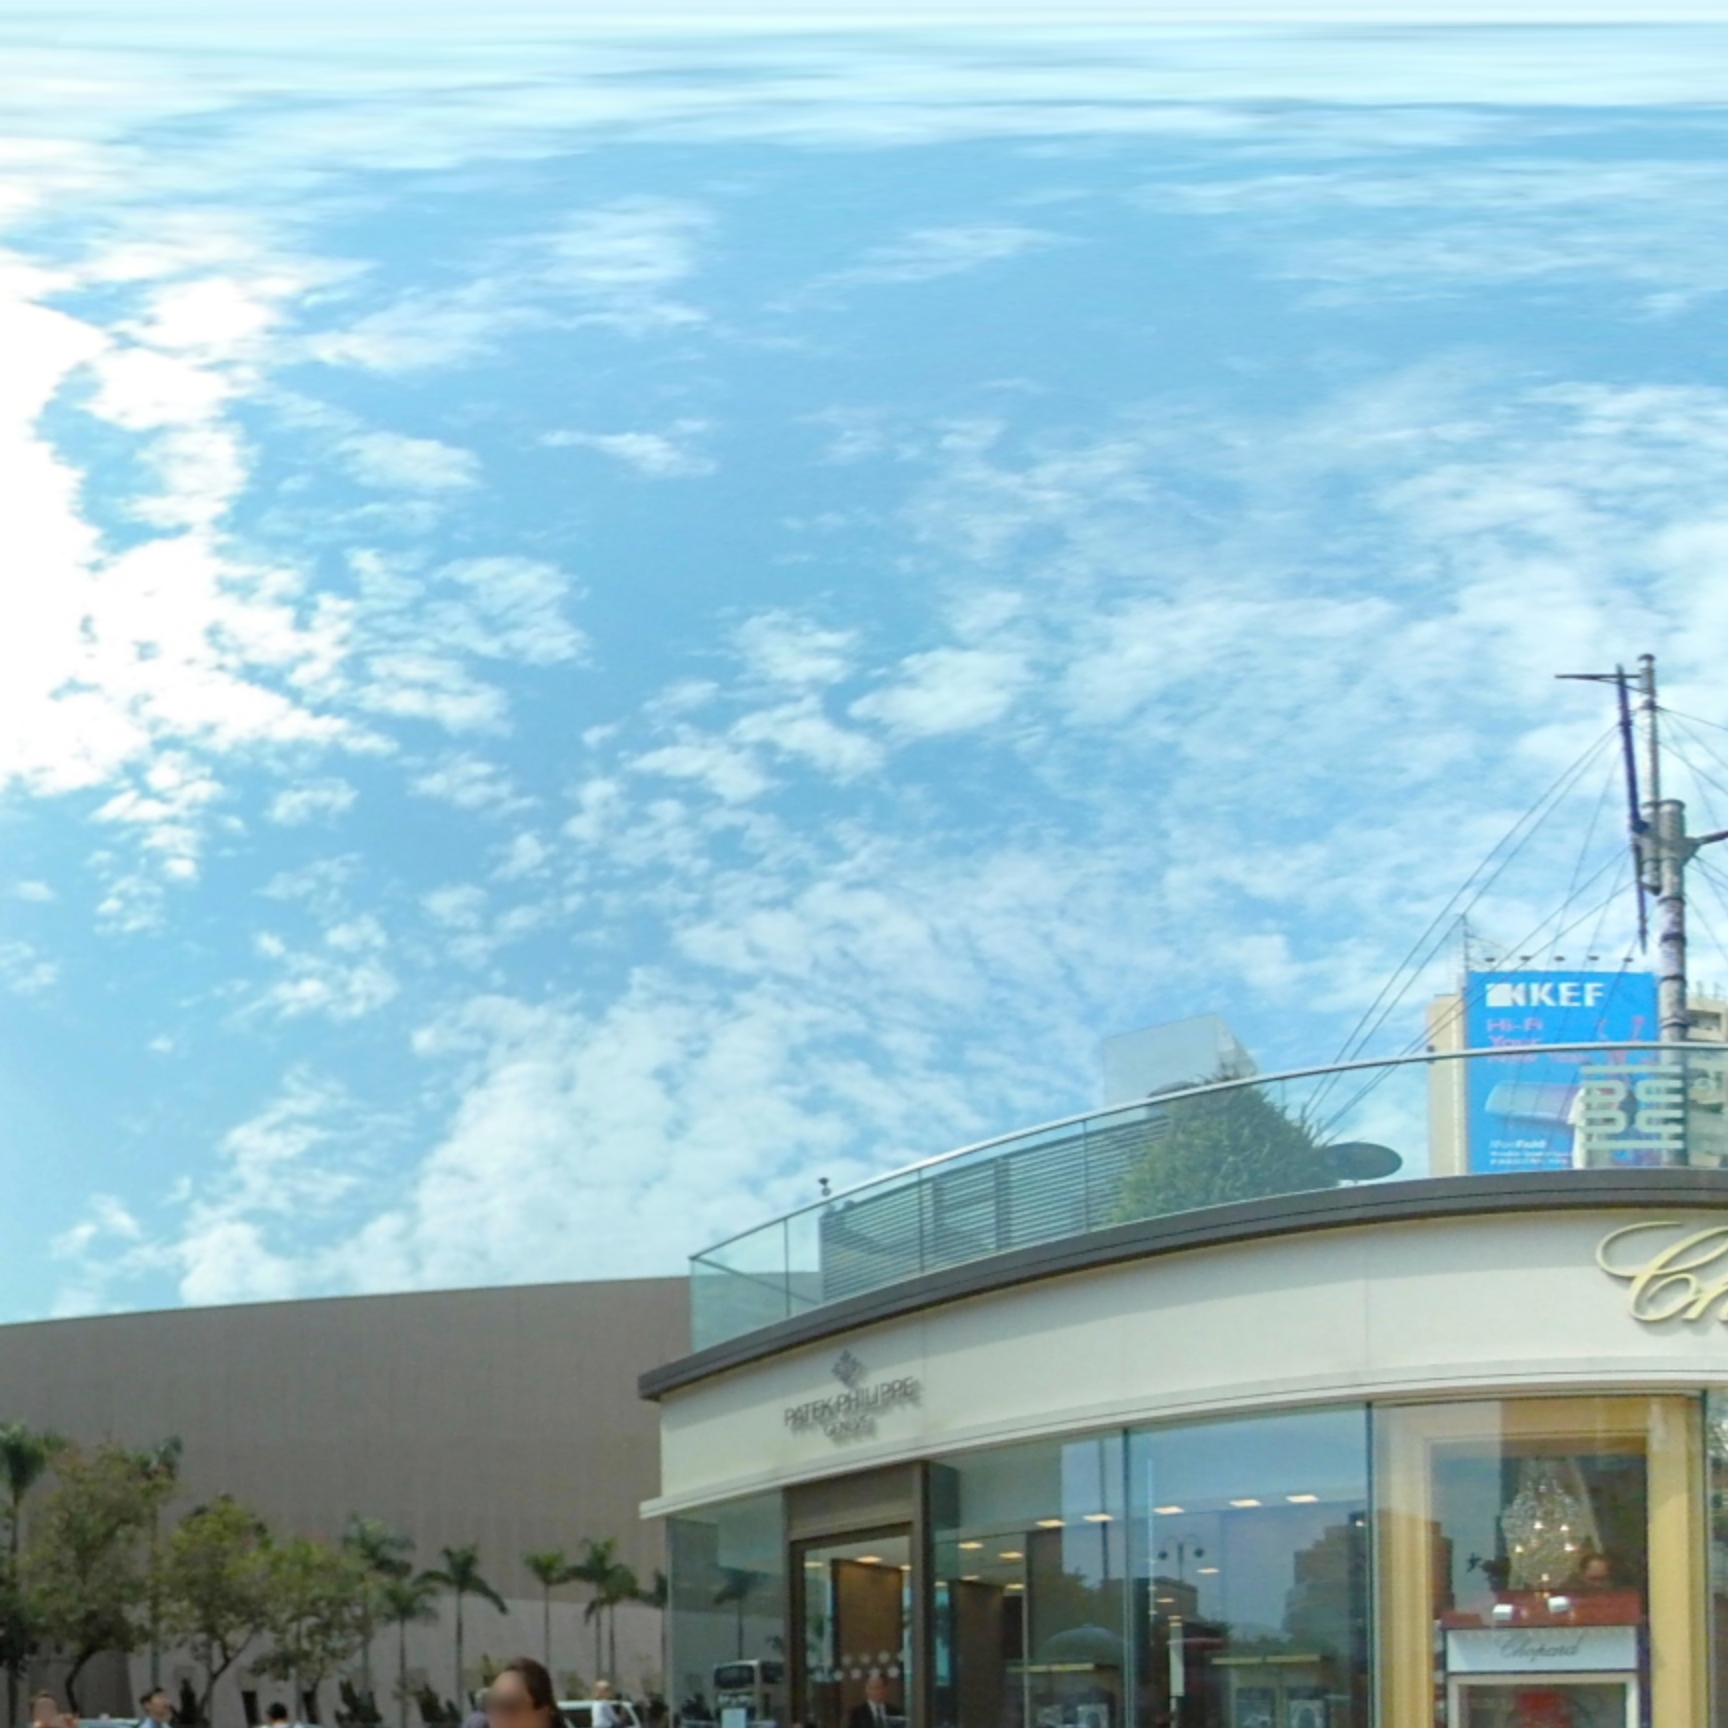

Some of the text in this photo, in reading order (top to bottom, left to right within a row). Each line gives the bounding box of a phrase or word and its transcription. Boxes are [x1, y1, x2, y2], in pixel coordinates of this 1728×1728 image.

[1529, 982, 1605, 1008] KEF
[784, 1376, 915, 1426] PATEK PHILIPPE
[1496, 1631, 1587, 1662] Chopard
